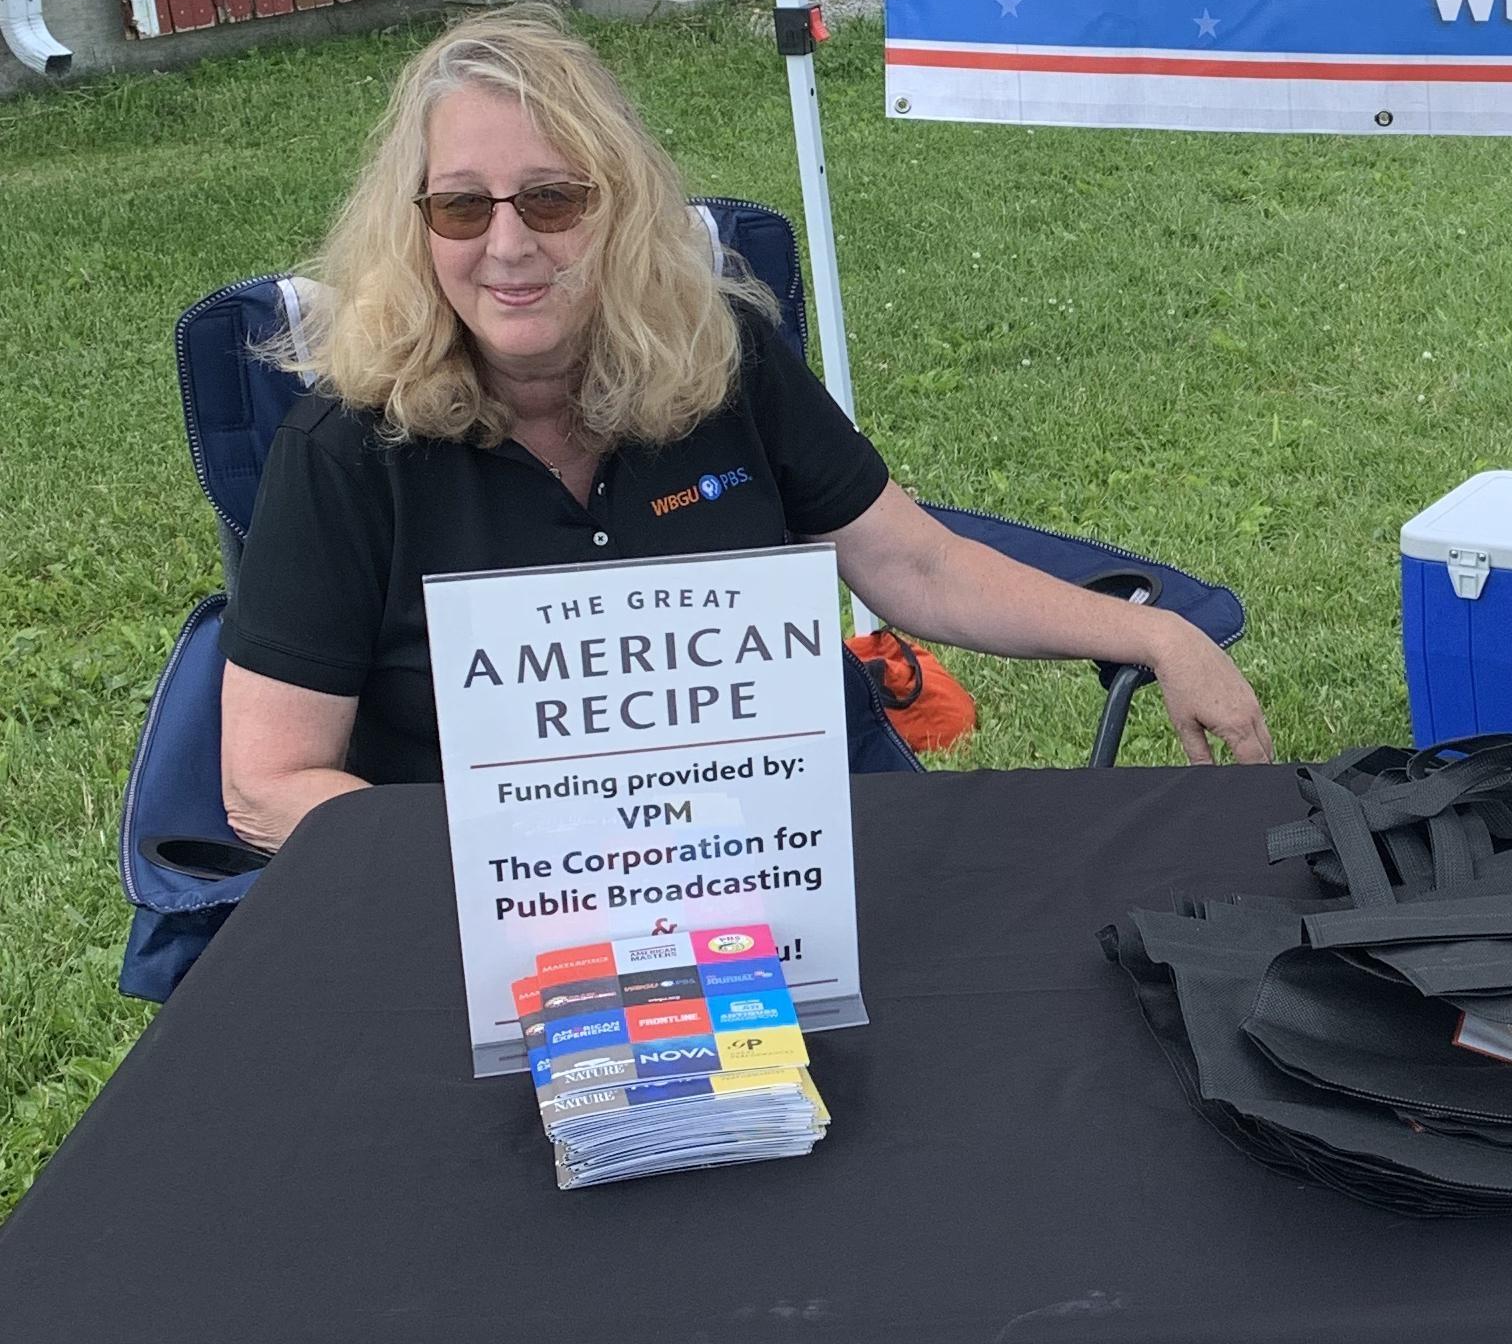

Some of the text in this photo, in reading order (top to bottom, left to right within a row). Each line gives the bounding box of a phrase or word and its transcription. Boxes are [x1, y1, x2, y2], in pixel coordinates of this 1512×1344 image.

[650, 467, 748, 516] WBGU PBS
[536, 589, 741, 624] THE GREAT
[463, 619, 822, 689] AMERICAN
[535, 681, 758, 739] RECIPE
[498, 756, 806, 804] Funding provided by:
[617, 800, 693, 829] VPM
[489, 826, 823, 882] The Corporation for
[496, 866, 823, 920] Public Broadcasting
[638, 1012, 699, 1027] FRONTLINE
[565, 1063, 625, 1084] NATURE
[640, 1047, 715, 1065] NOVA
[554, 1090, 615, 1112] NATURE
